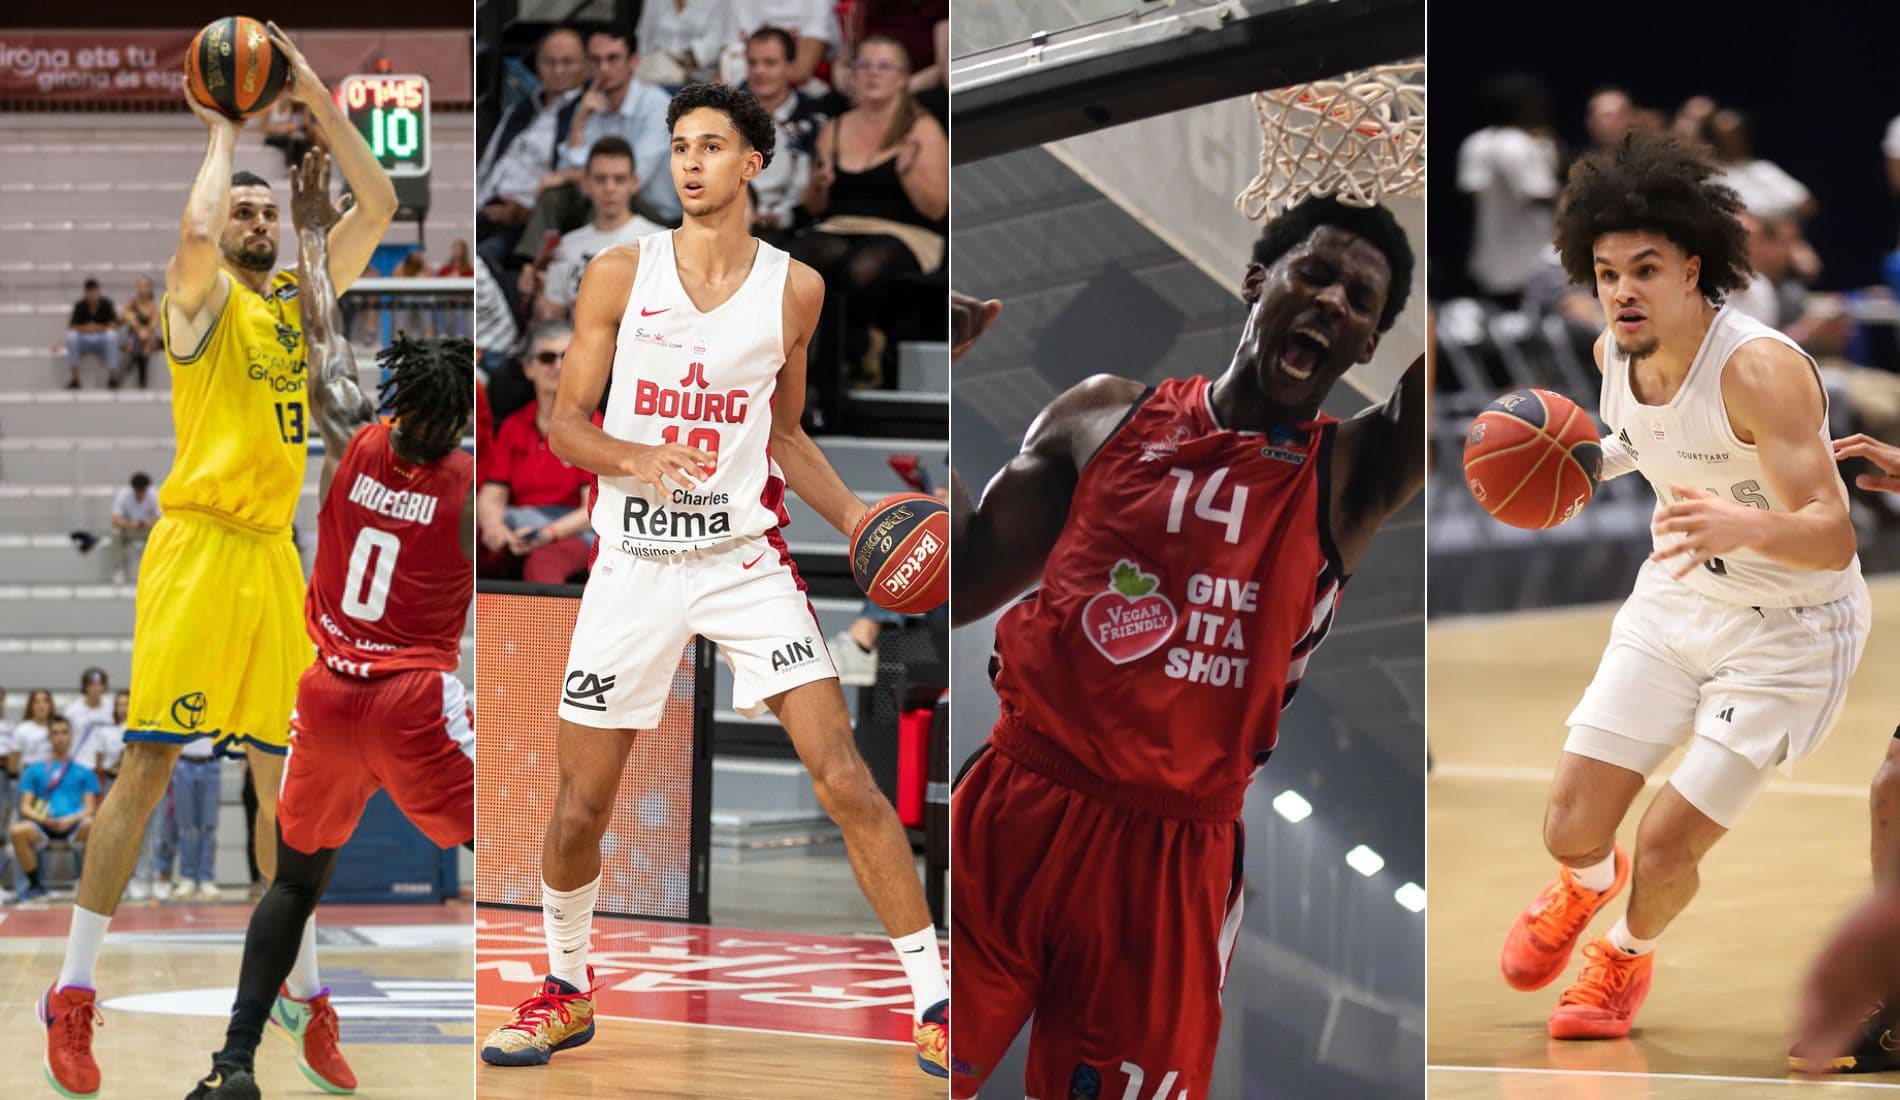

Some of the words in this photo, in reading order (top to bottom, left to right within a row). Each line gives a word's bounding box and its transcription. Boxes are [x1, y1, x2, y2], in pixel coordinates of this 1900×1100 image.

[75, 45, 120, 68] ets
[126, 45, 157, 67] tu
[371, 107, 418, 157] 10
[634, 379, 750, 424] BOURG
[274, 402, 305, 444] 13
[1677, 450, 1730, 461] COURTYARD
[623, 496, 731, 538] Réma
[672, 489, 729, 506] Charles
[1166, 467, 1249, 544] 14
[855, 505, 915, 575] SPALDING
[341, 526, 401, 622] 0
[886, 533, 938, 593] Betclic
[1186, 573, 1260, 612] GIVE
[1099, 615, 1168, 644] FRIENDLY
[1107, 603, 1161, 625] VEGAN
[1186, 611, 1224, 646] IT
[1221, 618, 1245, 650] A
[771, 641, 815, 671] AIN
[1164, 647, 1250, 689] SHOT
